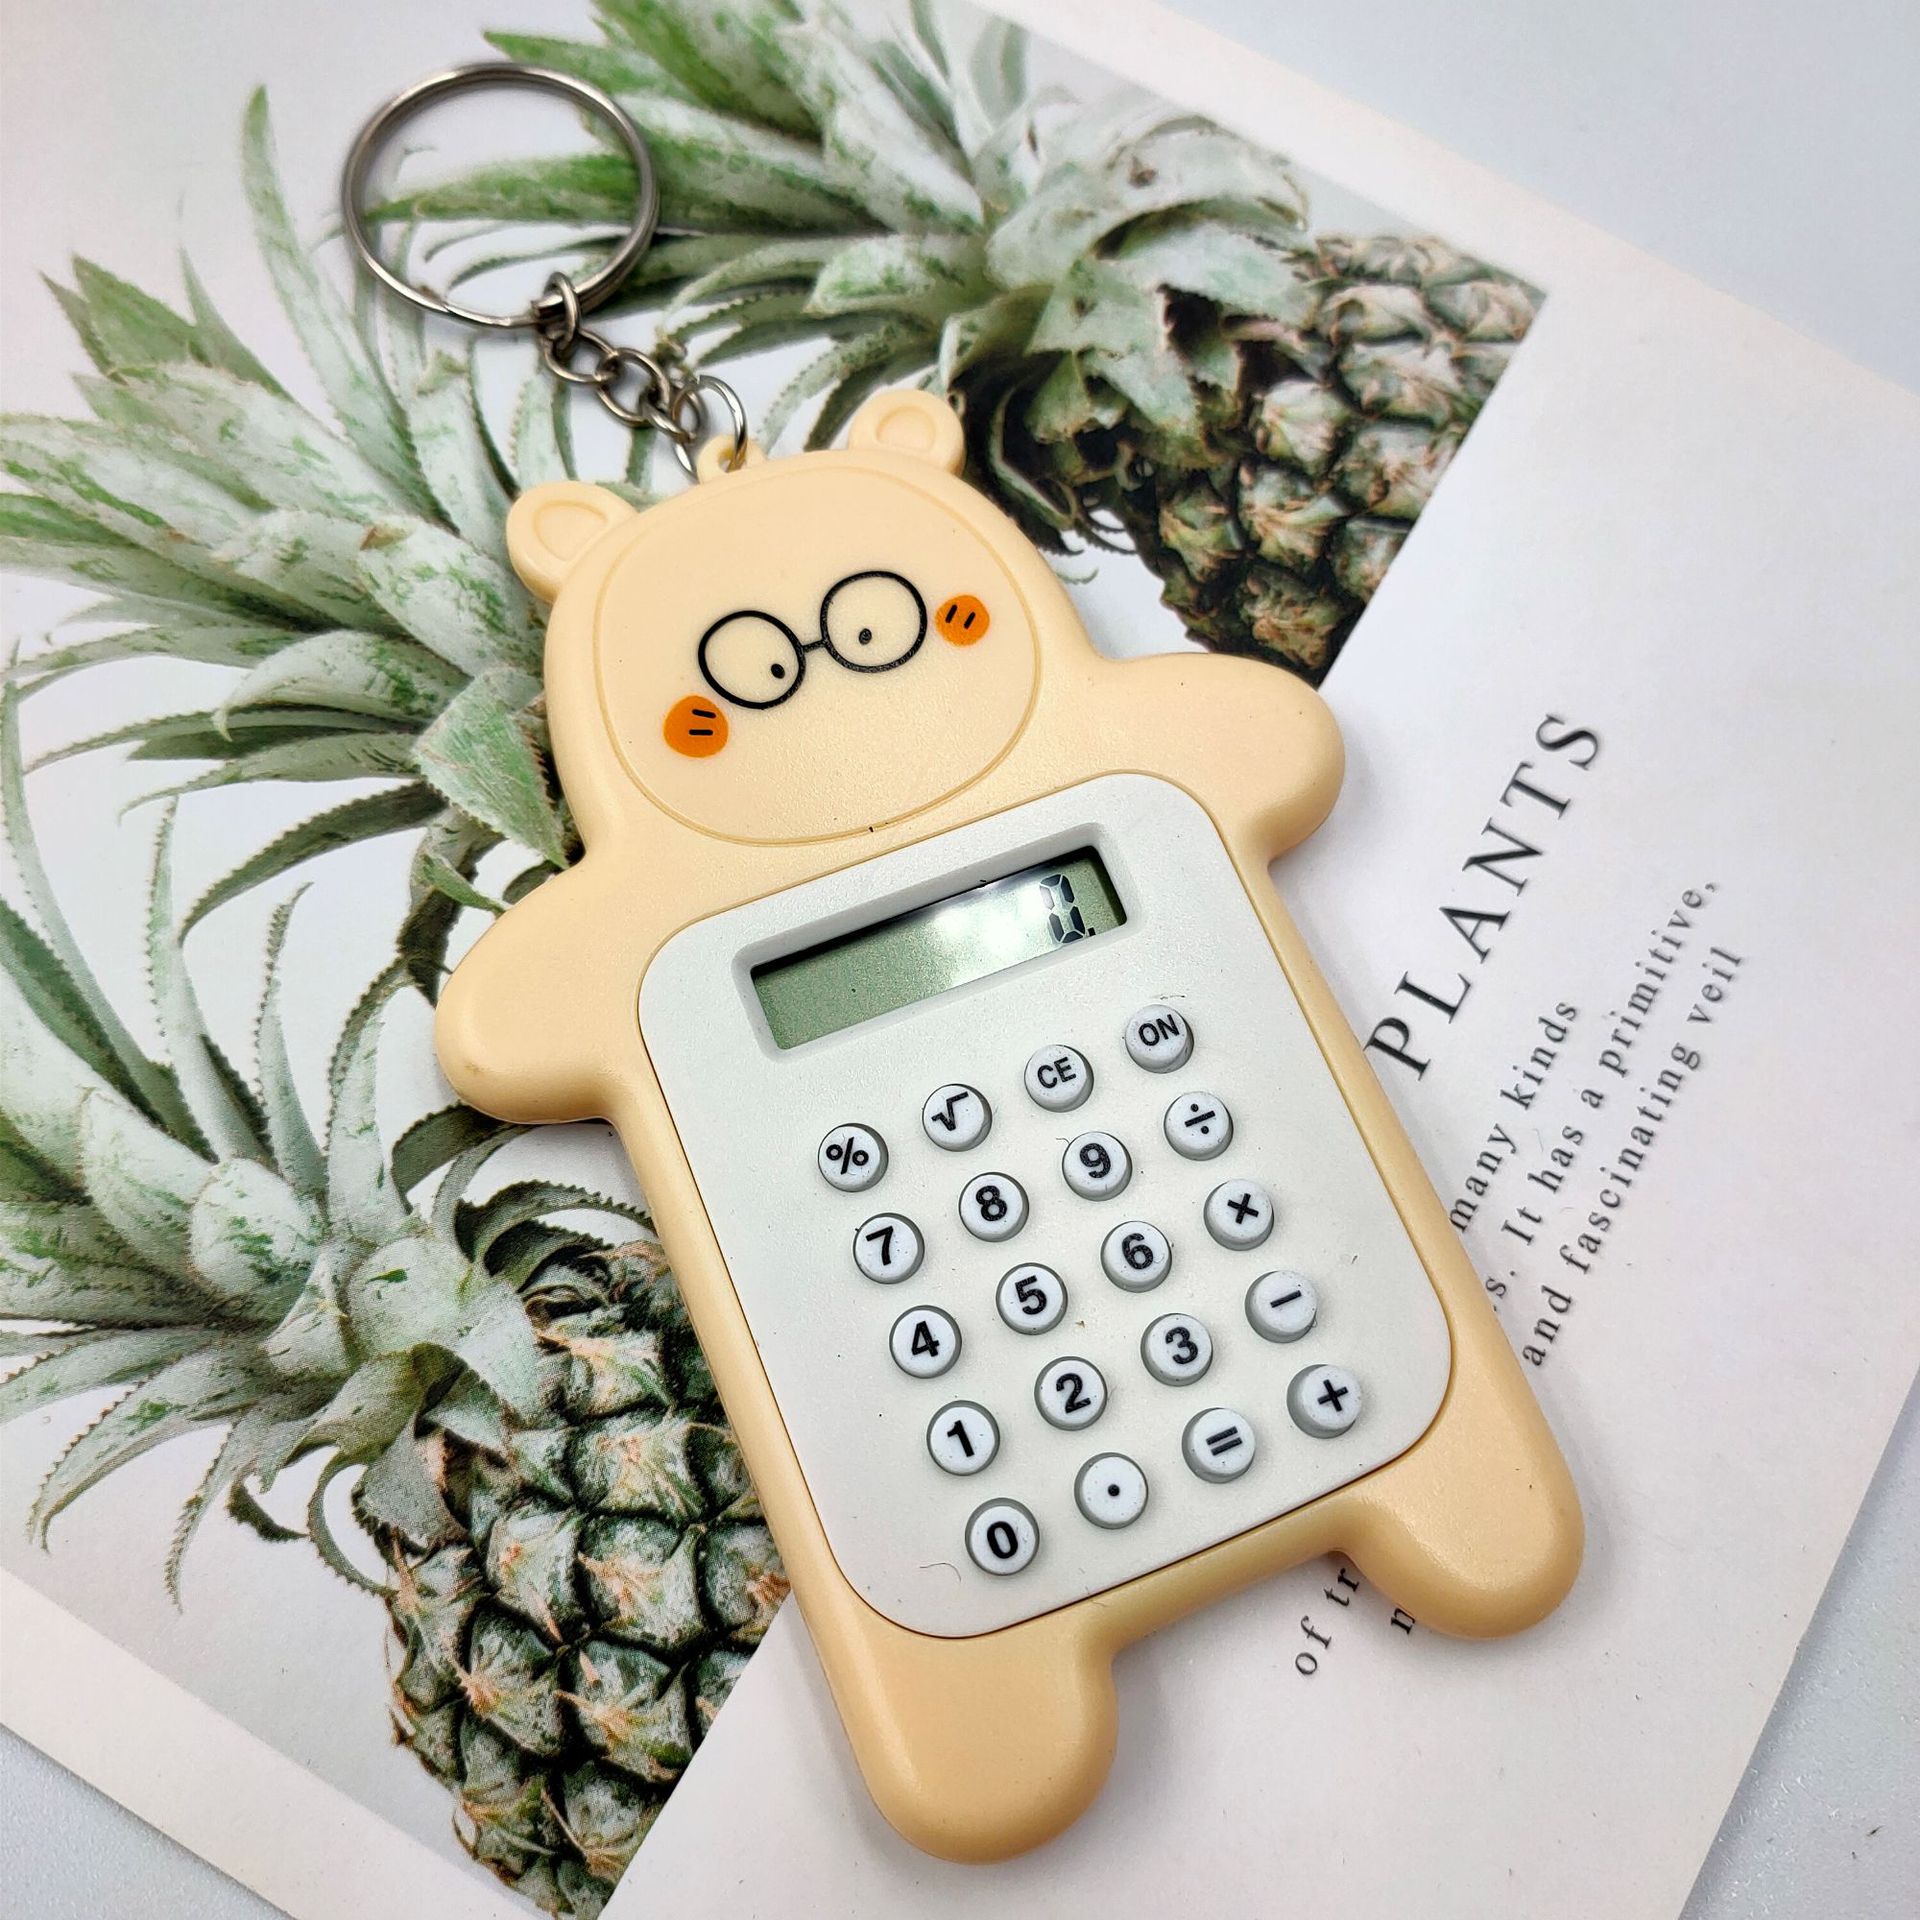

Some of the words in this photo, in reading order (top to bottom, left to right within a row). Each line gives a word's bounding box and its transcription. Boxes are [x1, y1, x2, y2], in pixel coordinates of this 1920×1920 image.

[1363, 711, 1602, 1081] PLANTS
[1036, 1056, 1077, 1090] CE
[1138, 1013, 1181, 1048] ON
[1449, 1122, 1519, 1234] many
[1501, 1000, 1579, 1111] kinds
[865, 1225, 895, 1266] 7
[976, 1185, 1008, 1222] 8
[1079, 1143, 1112, 1179] 9
[1522, 1285, 1573, 1367] and
[1560, 1045, 1702, 1275] fascinating
[1687, 946, 1745, 1028] veil
[911, 1320, 941, 1358] 4
[1016, 1275, 1047, 1316] 5
[1121, 1233, 1154, 1270] 6
[1295, 1615, 1333, 1676] of
[1502, 1206, 1543, 1246] It
[1527, 1124, 1585, 1194] has
[1580, 1087, 1605, 1109] a
[1599, 881, 1720, 1078] primitive,
[946, 1420, 975, 1458] 1
[1055, 1373, 1092, 1414] 2
[1165, 1326, 1199, 1365] 3
[986, 1520, 1019, 1560] 0
